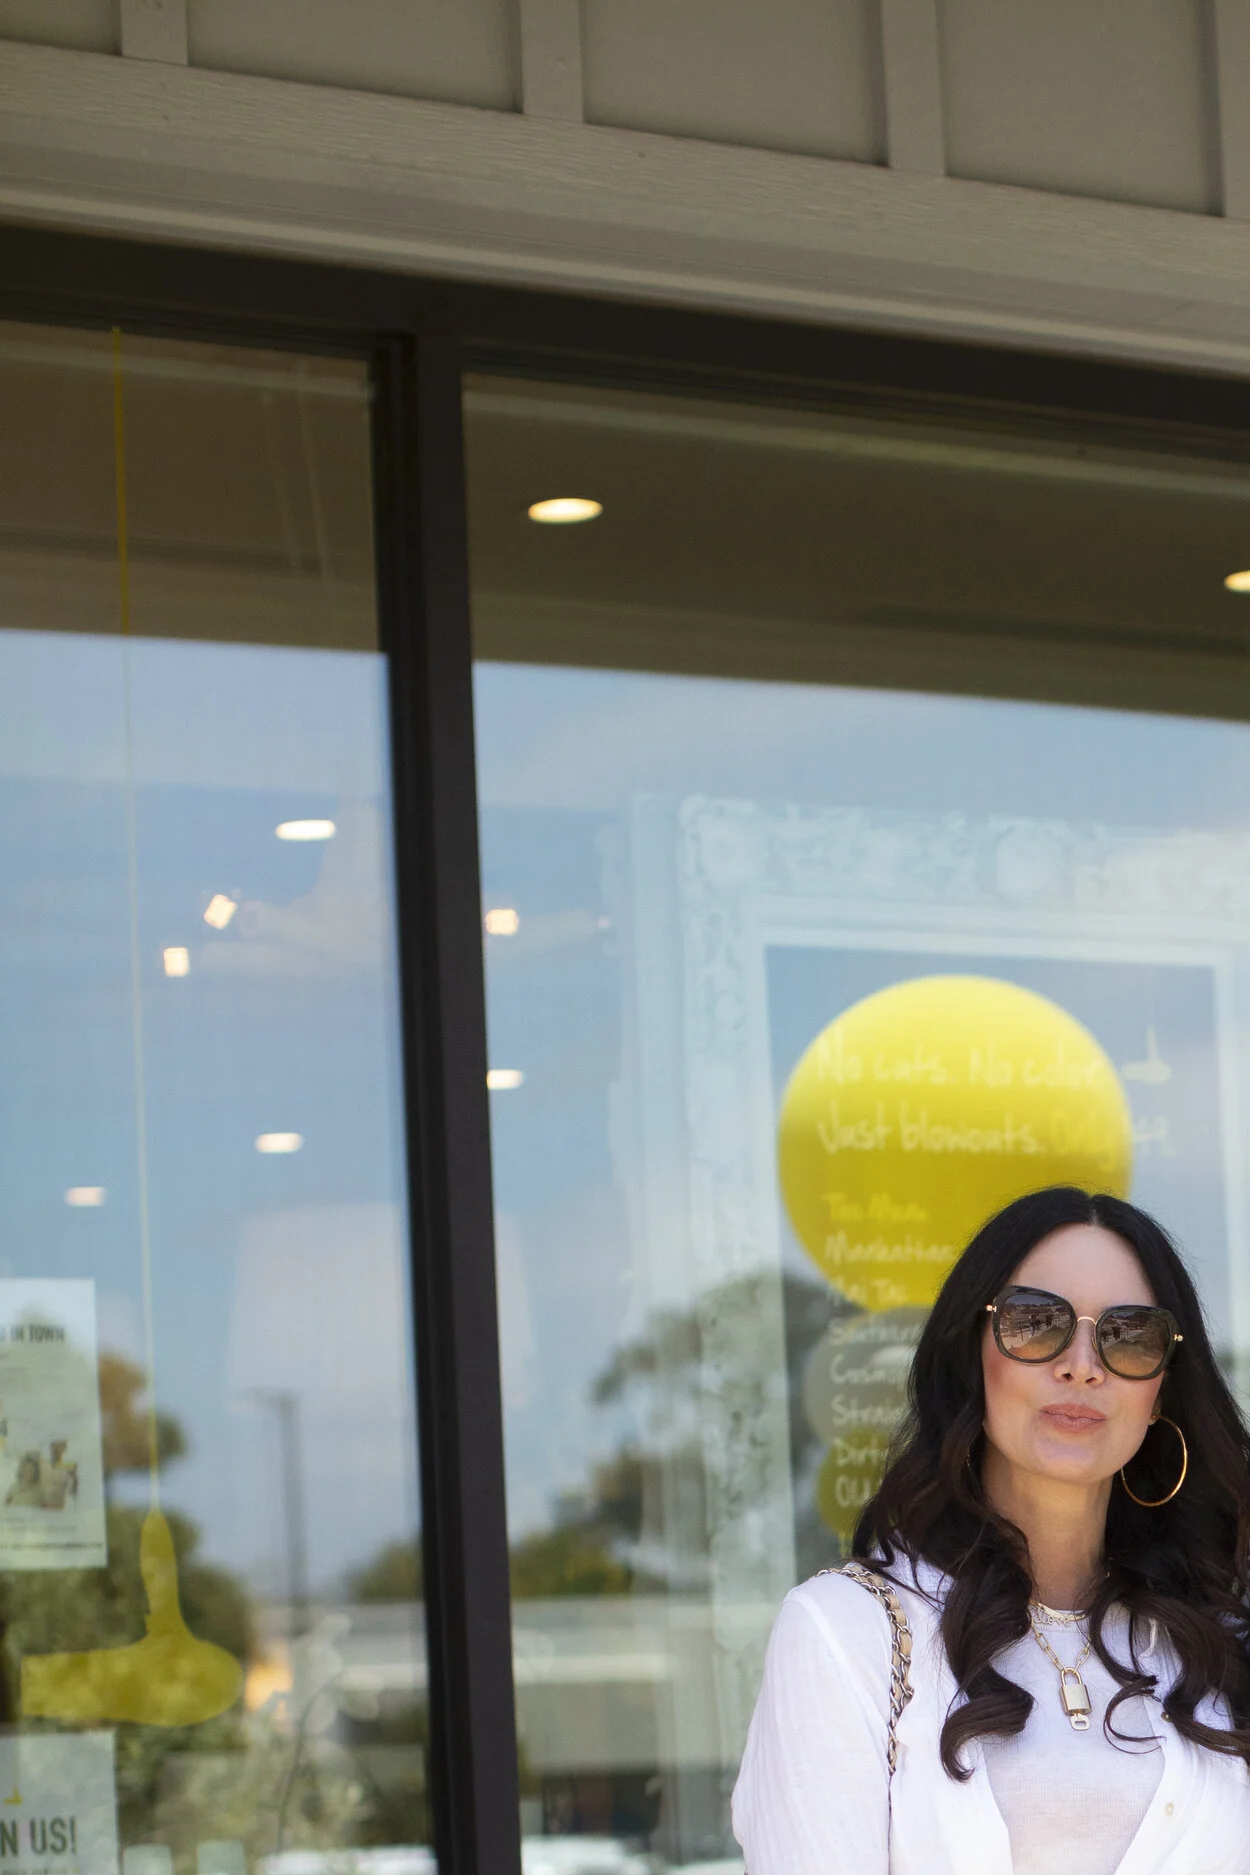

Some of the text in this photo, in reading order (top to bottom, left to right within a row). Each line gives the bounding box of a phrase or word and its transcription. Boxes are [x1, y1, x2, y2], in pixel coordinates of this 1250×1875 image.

[816, 1099, 891, 1154] Just
[28, 1323, 65, 1343] TOWN
[29, 1815, 77, 1856] US!
